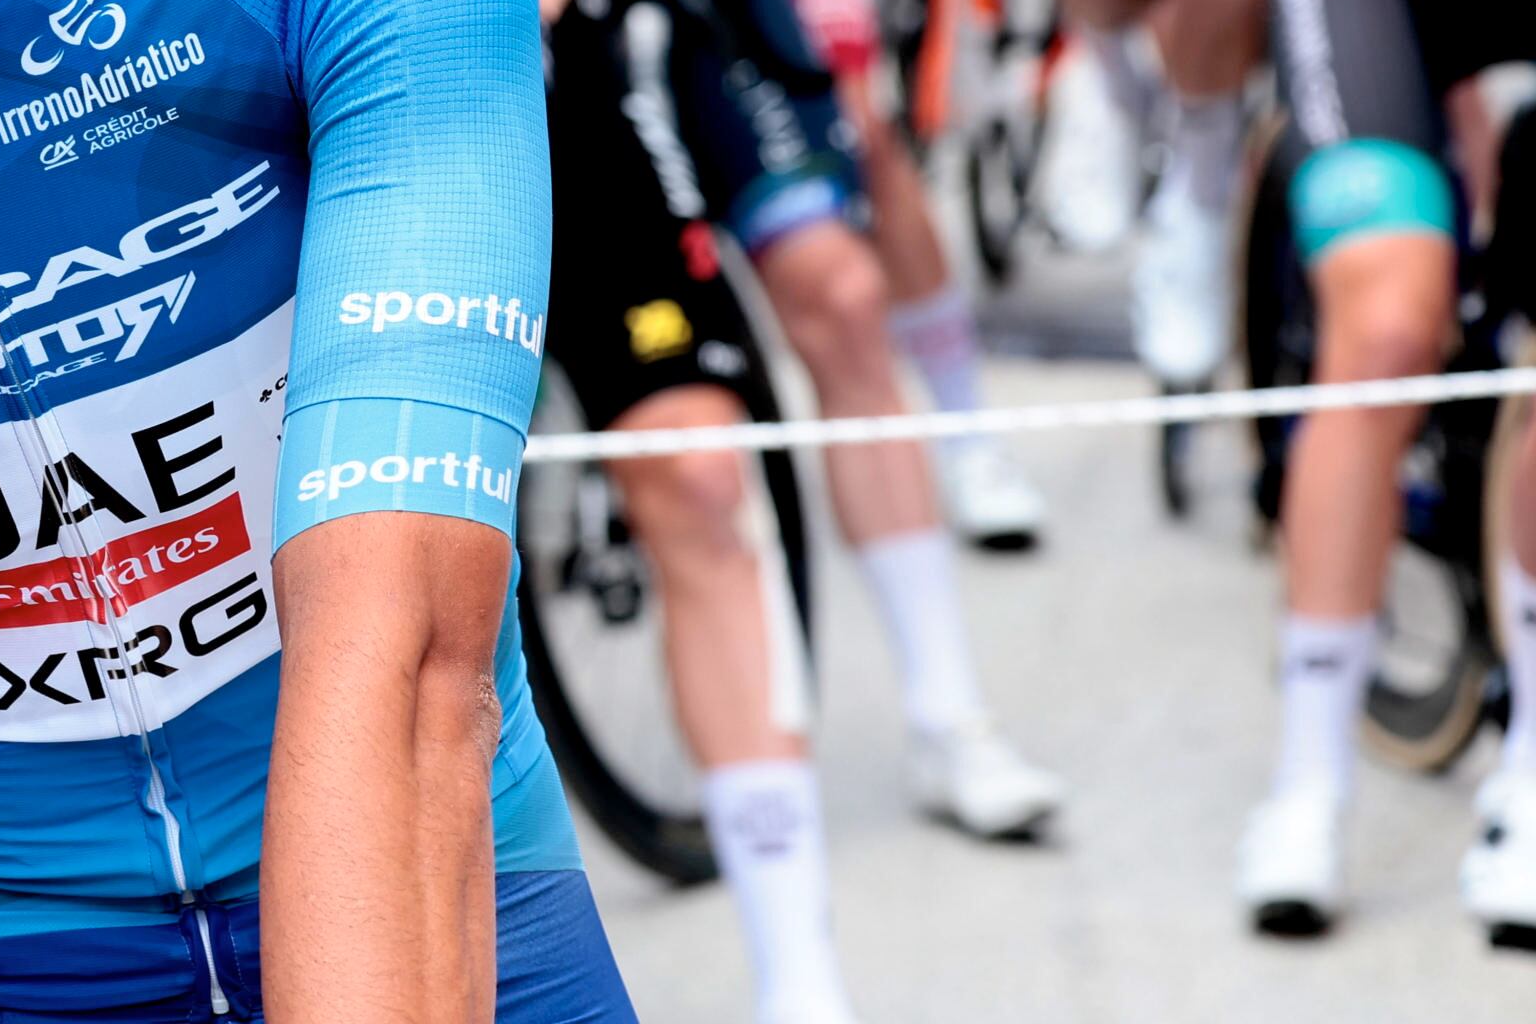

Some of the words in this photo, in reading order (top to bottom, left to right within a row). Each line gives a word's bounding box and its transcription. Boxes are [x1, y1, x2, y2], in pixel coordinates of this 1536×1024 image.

[83, 107, 149, 141] CRÉDIT
[89, 107, 180, 154] AGRICOLE
[339, 290, 543, 359] sportful
[297, 452, 512, 505] sportful
